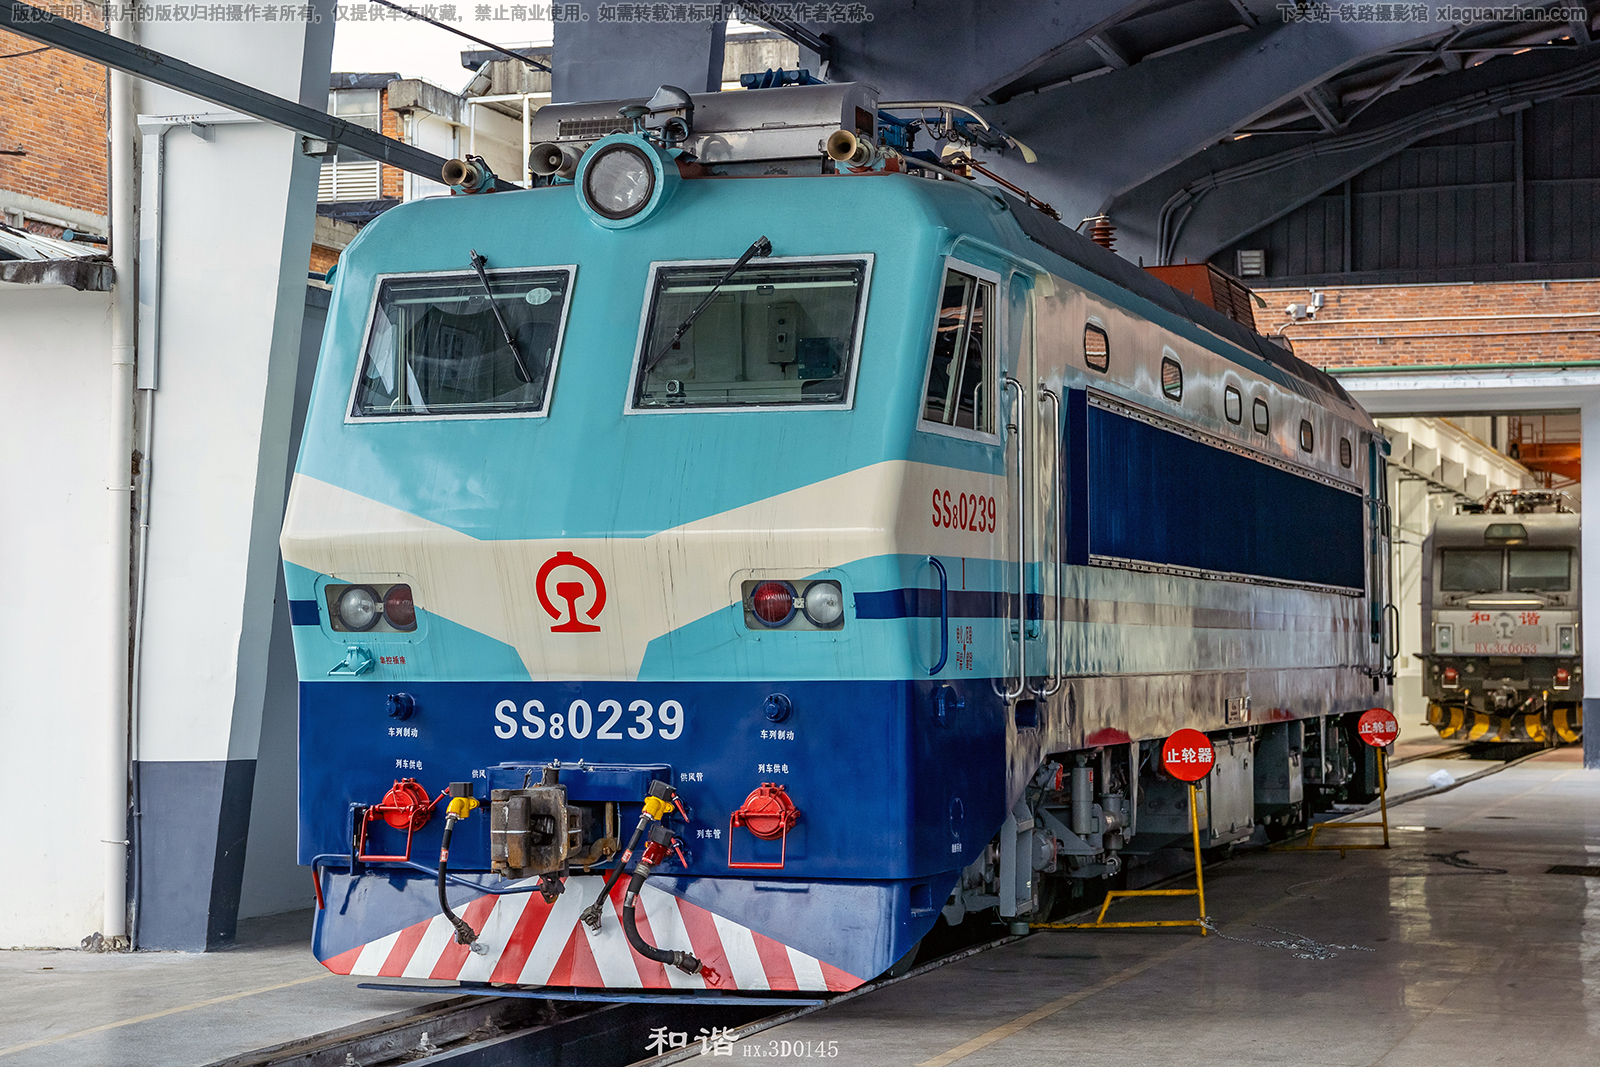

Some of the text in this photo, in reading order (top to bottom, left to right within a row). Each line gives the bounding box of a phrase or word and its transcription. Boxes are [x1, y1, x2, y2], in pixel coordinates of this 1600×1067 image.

[932, 488, 996, 533] SS80239
[494, 699, 684, 740] SS80239
[388, 727, 418, 738] 车列制动
[1359, 721, 1397, 734] 止轮器
[760, 729, 795, 740] 车列制动
[1166, 747, 1213, 764] 止轮器
[395, 759, 423, 770] 列车供电
[758, 763, 789, 774] 列车供电
[680, 772, 704, 782] 供风管
[696, 829, 721, 839] 列车管
